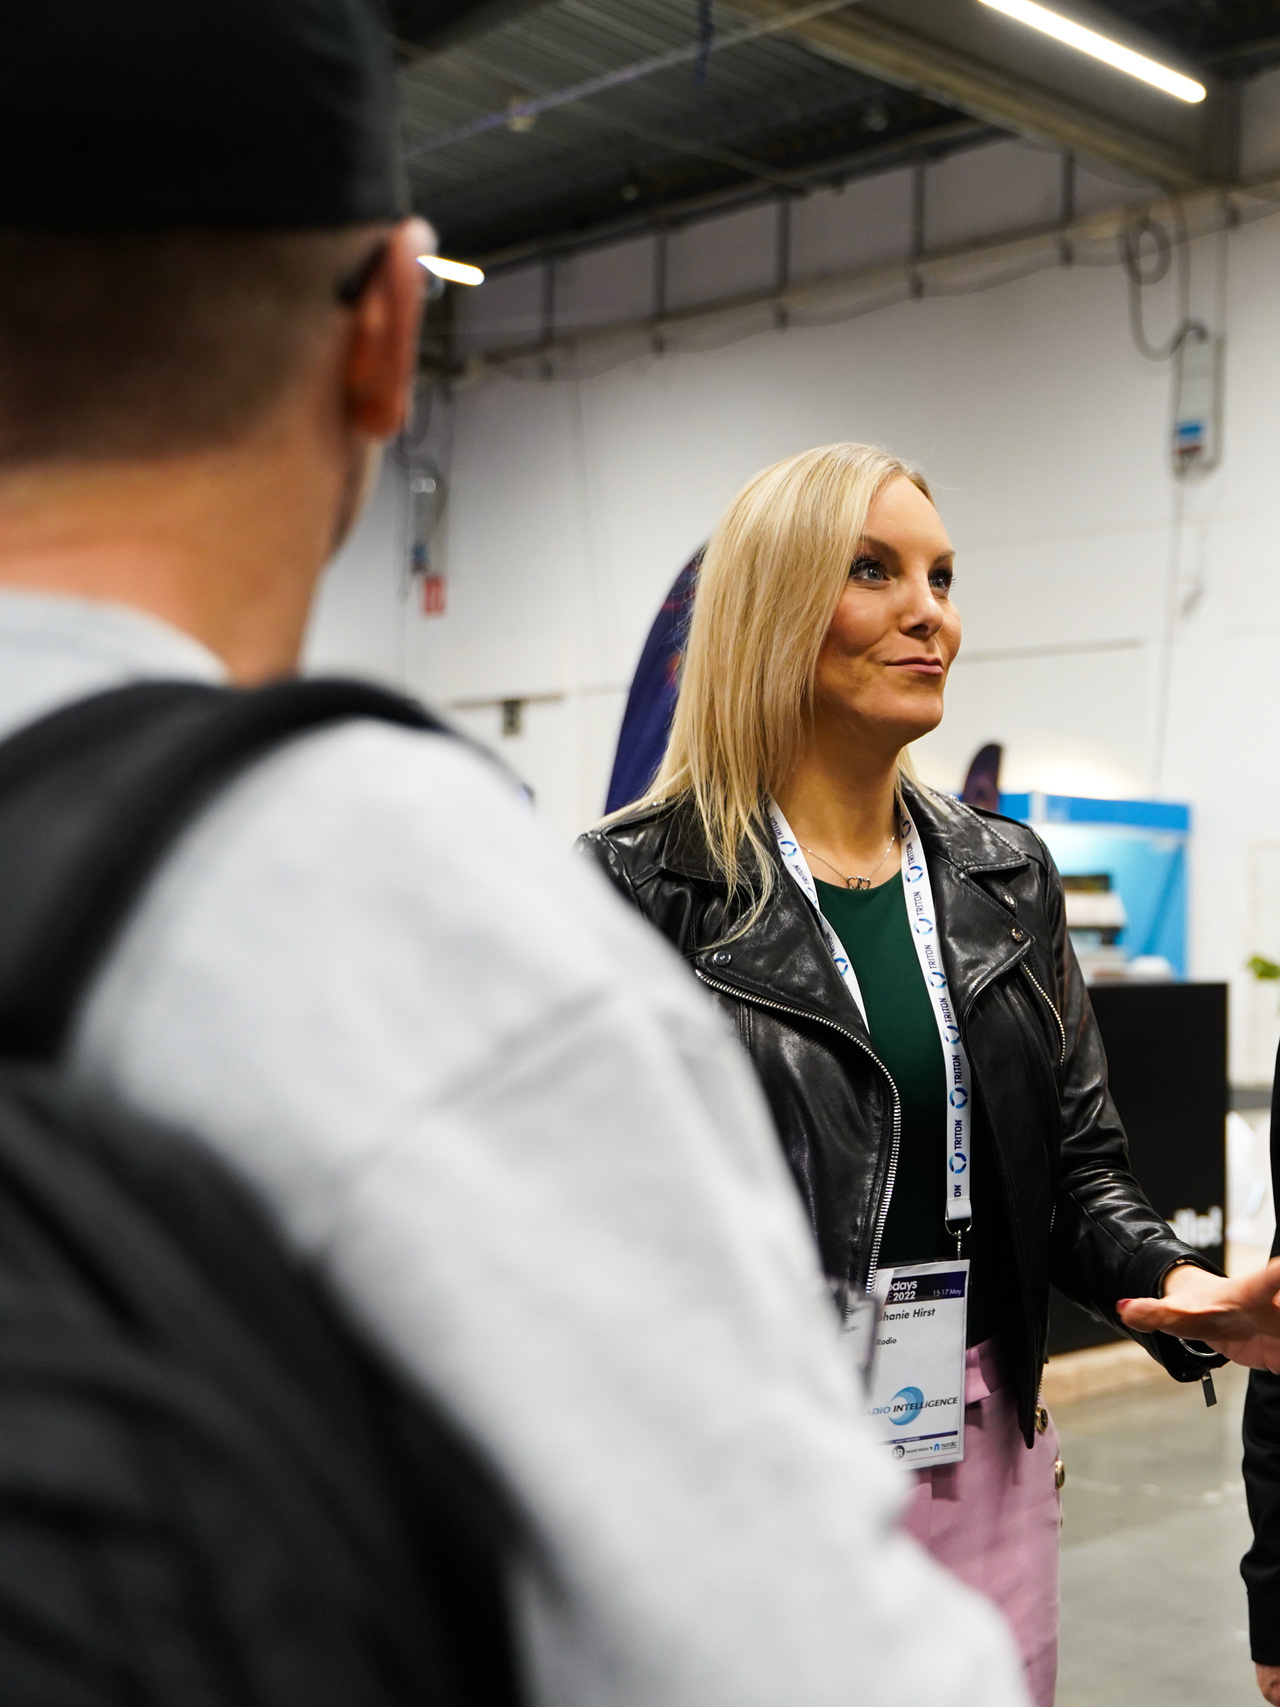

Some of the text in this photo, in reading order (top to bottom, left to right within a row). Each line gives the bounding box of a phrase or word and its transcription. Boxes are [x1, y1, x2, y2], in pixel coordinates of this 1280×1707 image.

[905, 842, 916, 866] TRITON
[913, 890, 925, 916] TRITON
[924, 944, 938, 970] TRITON
[940, 997, 953, 1024] TRITON
[952, 1054, 963, 1085] TRITON
[954, 1119, 963, 1151] TRITON
[893, 1290, 916, 1302] 2022
[933, 1288, 949, 1297] 15-17
[912, 1307, 936, 1318] Hirst
